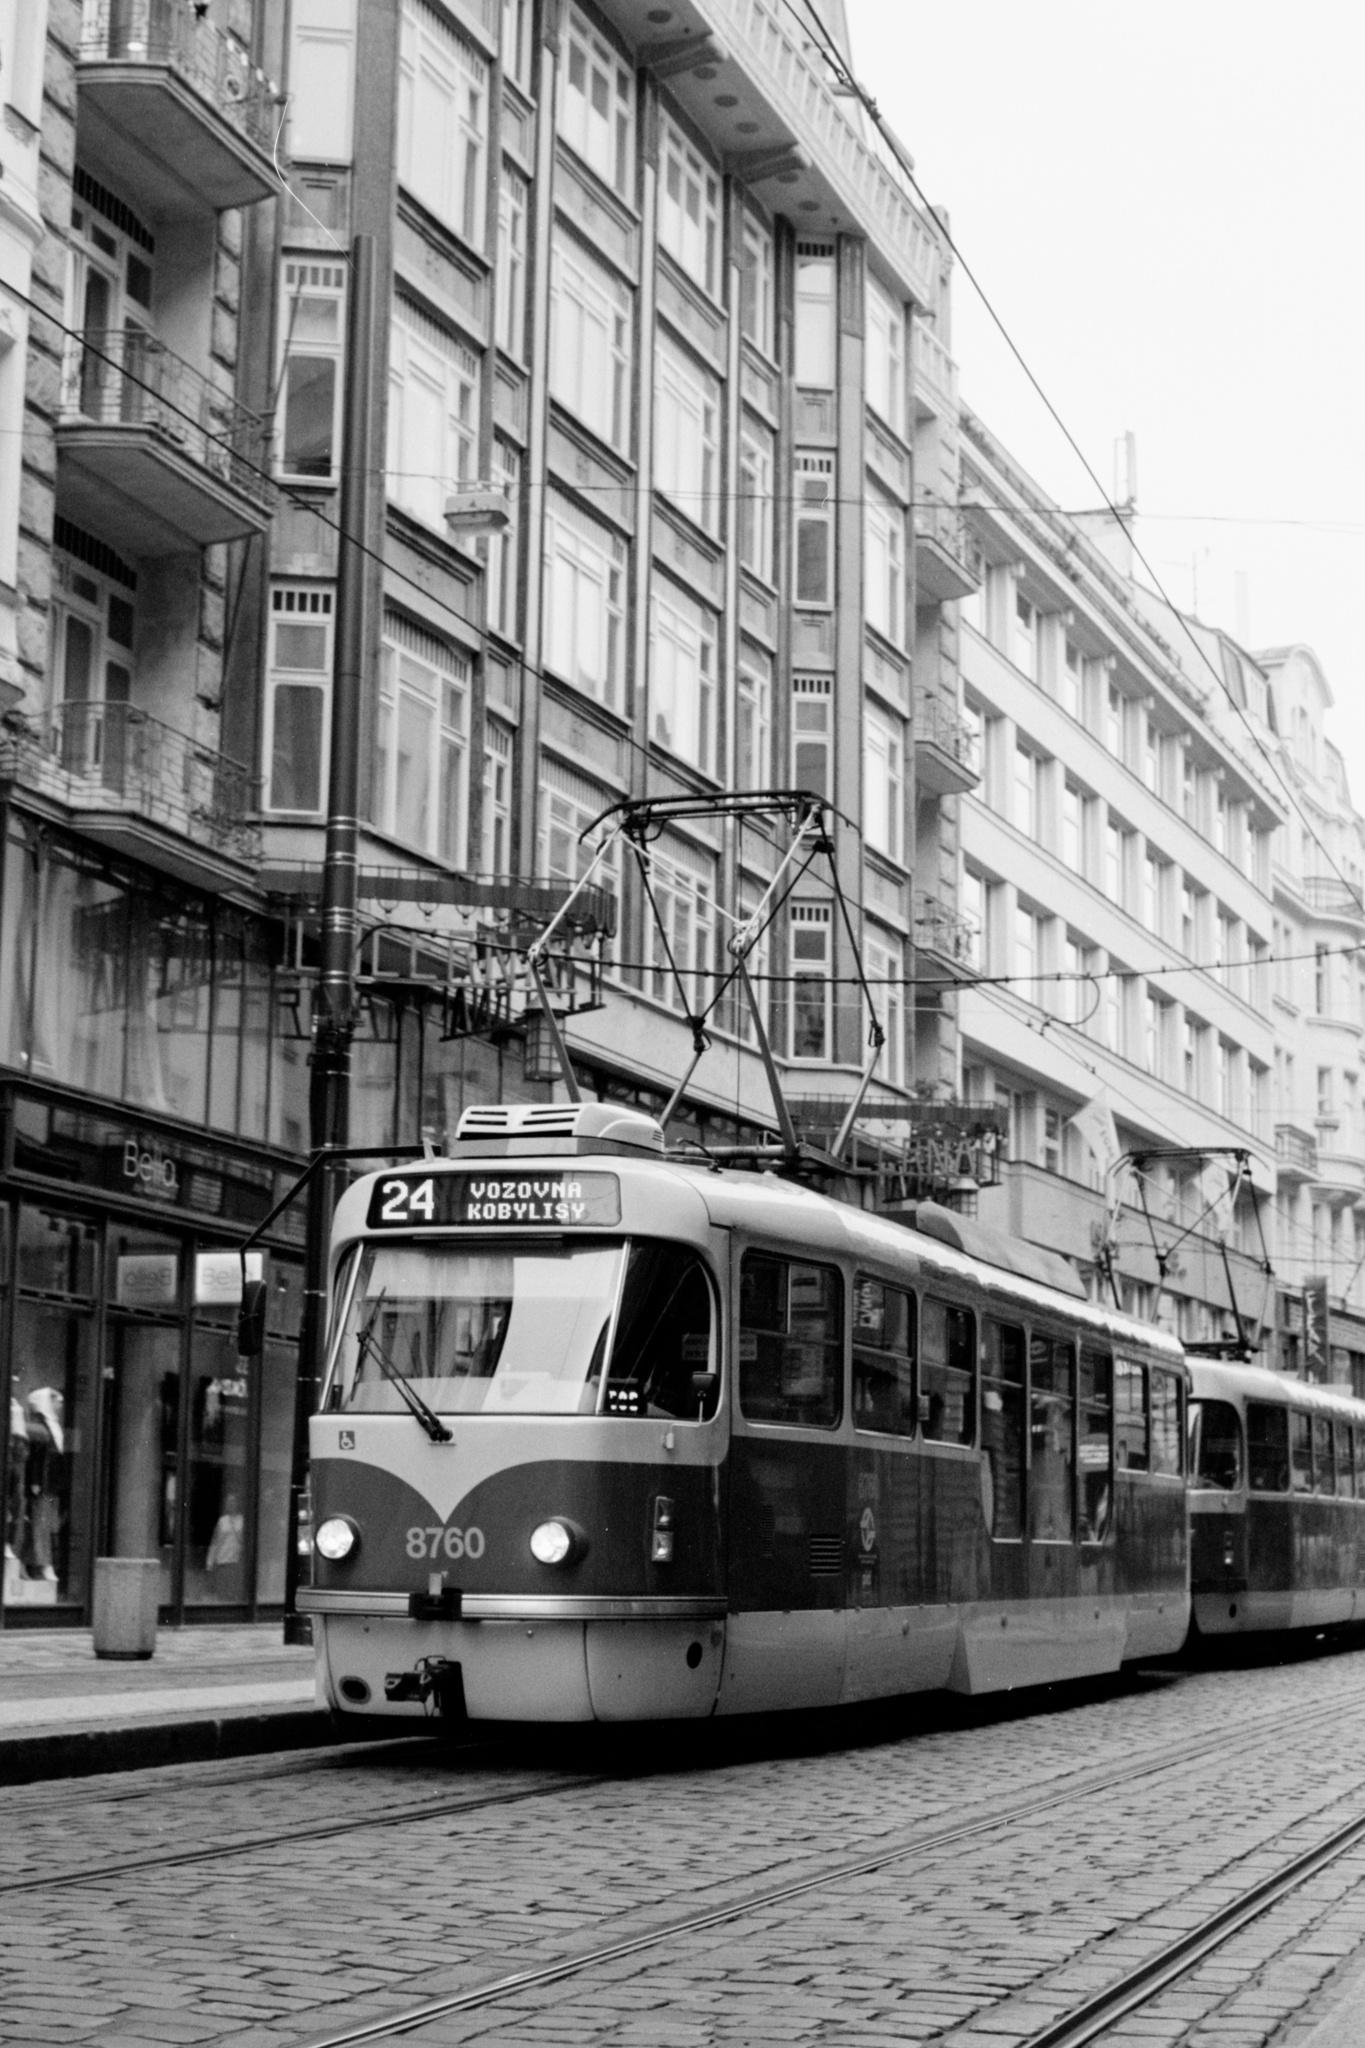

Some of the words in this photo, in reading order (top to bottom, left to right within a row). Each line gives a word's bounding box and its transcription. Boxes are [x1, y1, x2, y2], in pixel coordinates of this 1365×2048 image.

[381, 1179, 435, 1220] 24
[470, 1182, 582, 1199] VOZOVNA
[467, 1203, 585, 1220] KOBYLISY
[406, 1527, 485, 1559] 8760
